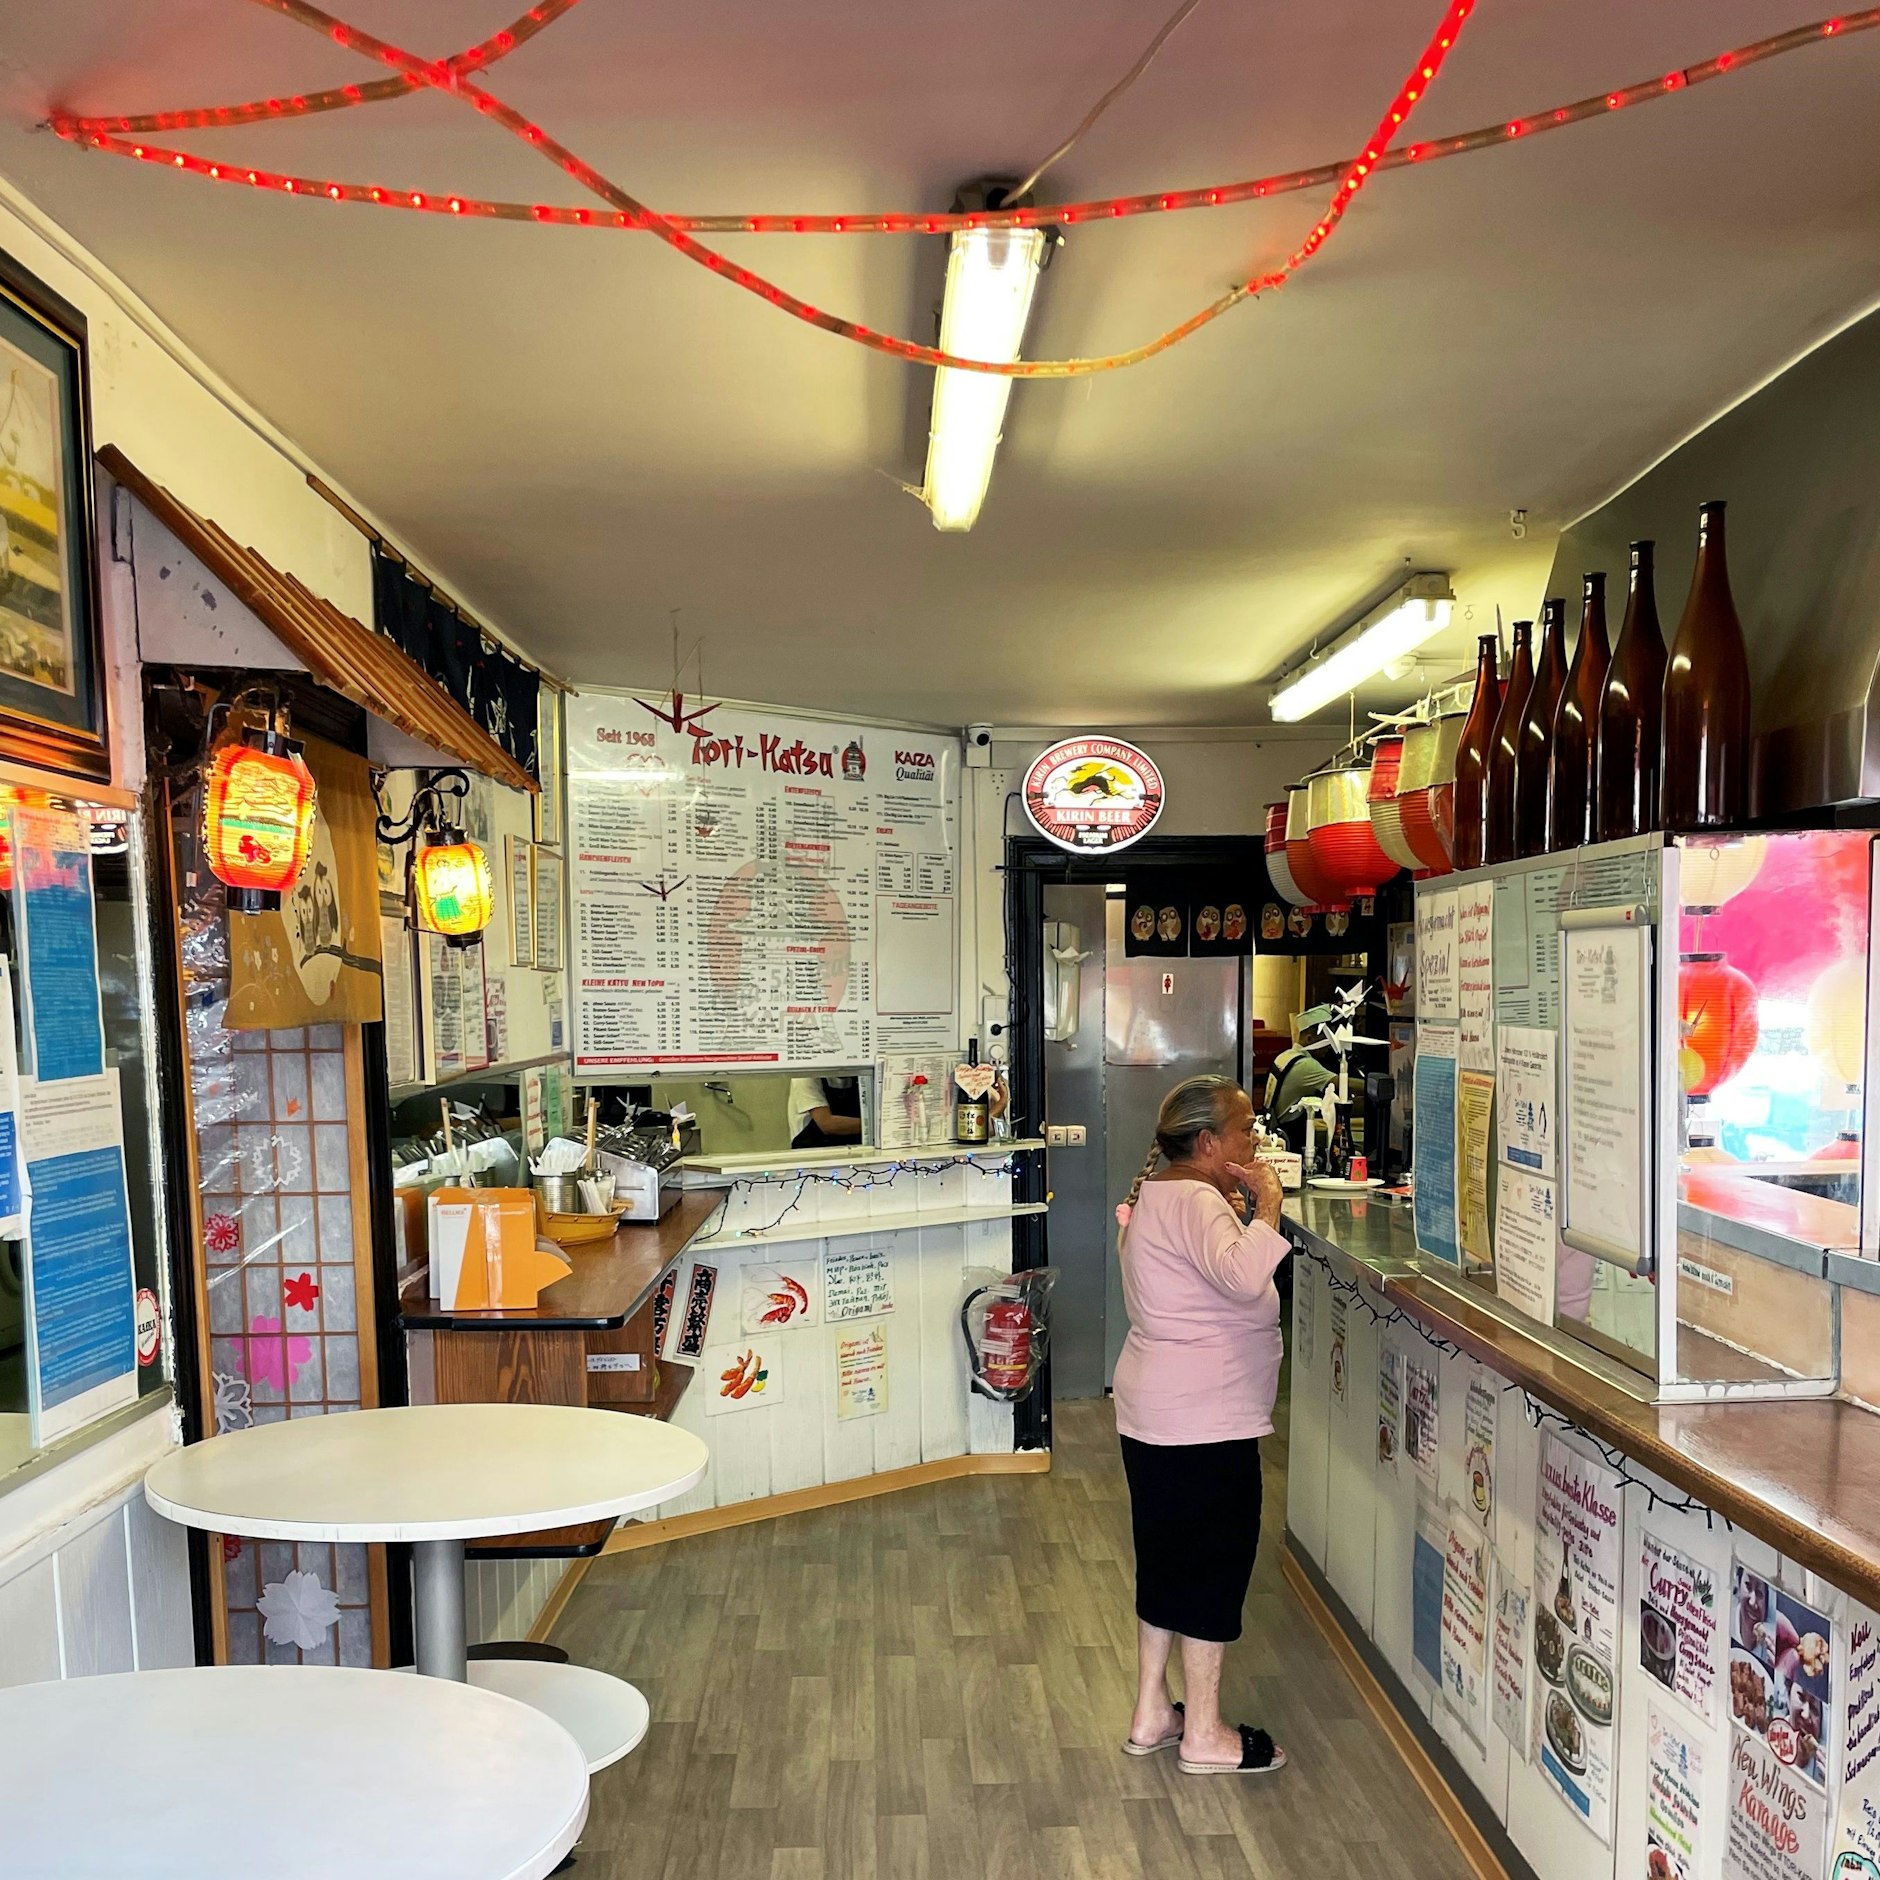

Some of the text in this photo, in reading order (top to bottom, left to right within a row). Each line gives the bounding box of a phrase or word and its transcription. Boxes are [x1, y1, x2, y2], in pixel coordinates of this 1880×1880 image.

[596, 728, 655, 747] Seit 1968
[687, 722, 834, 778] Tori-Katsu
[896, 767, 934, 782] Qualität
[1031, 744, 1158, 790] KIRIN BREWERY COMPANY LIMITED
[1056, 810, 1131, 823] KIRIN BEER
[1420, 942, 1451, 988] Spezial
[1581, 1481, 1616, 1527] Klasse
[1448, 1530, 1465, 1560] Origami
[1650, 1562, 1688, 1607] Curry
[1761, 1758, 1807, 1821] Wings
[1738, 1779, 1800, 1854] Karaage
